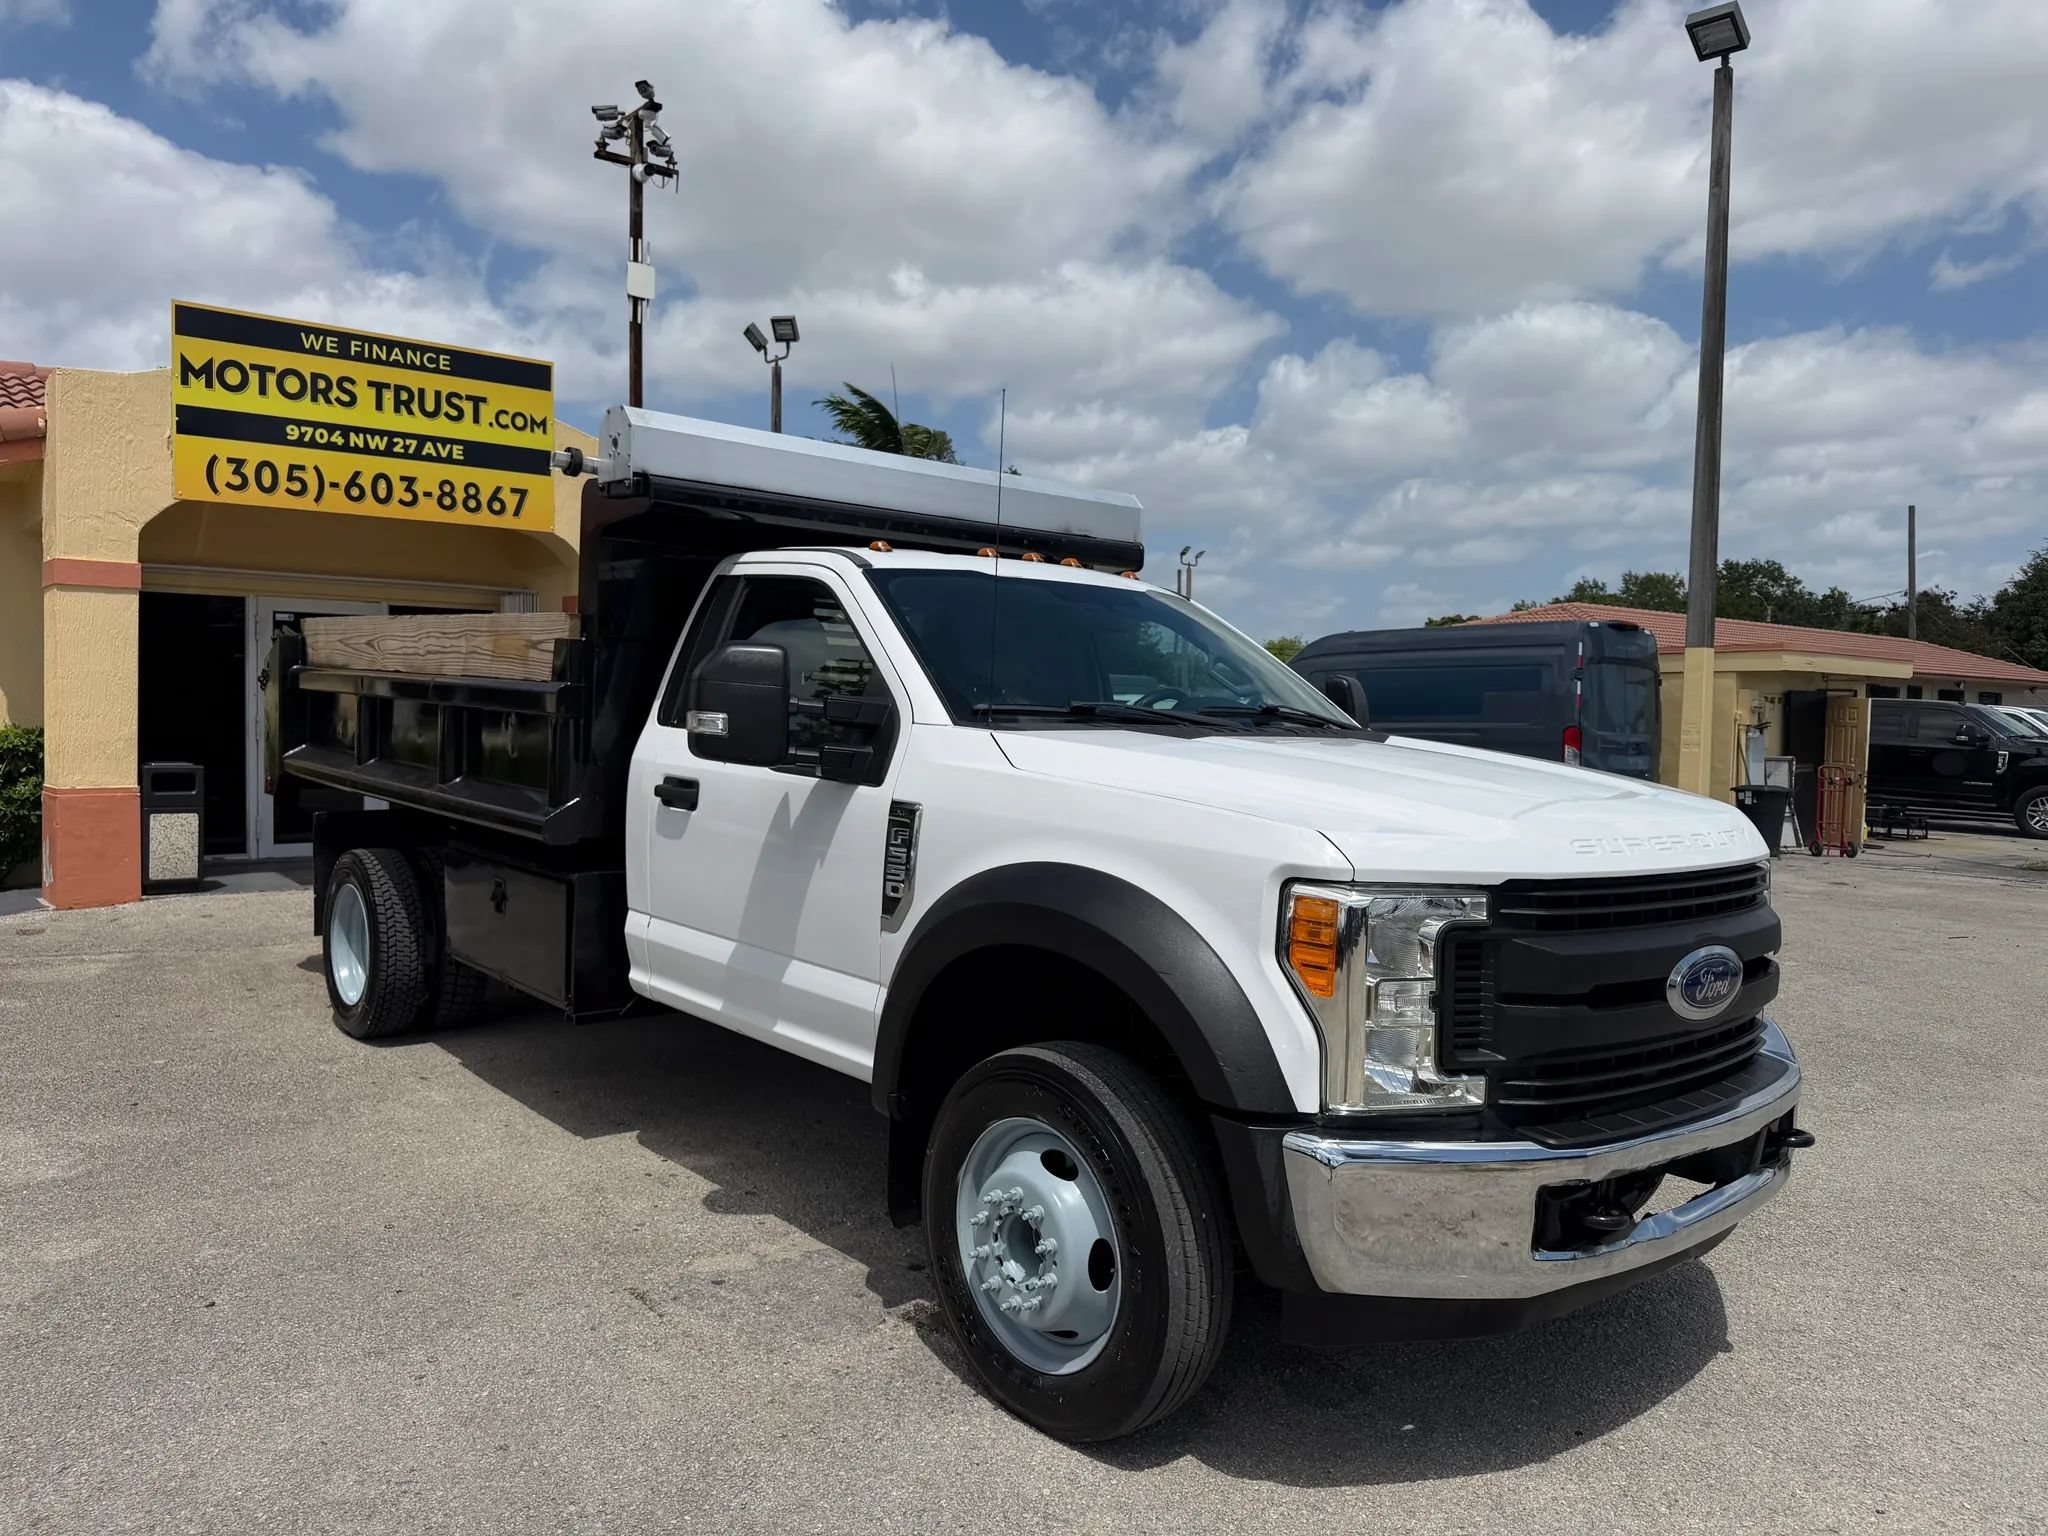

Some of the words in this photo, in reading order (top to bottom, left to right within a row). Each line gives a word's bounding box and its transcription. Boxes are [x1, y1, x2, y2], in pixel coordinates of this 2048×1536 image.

[300, 331, 340, 354] WE
[350, 339, 452, 371] FINANCE
[179, 351, 359, 409] MOTORS
[285, 423, 345, 447] 9704
[349, 431, 388, 452] NW
[392, 436, 418, 455] 27
[421, 440, 465, 461] AVE
[205, 453, 530, 519] (305)-603-8867
[1569, 835, 1686, 857] SUPER
[1696, 965, 1730, 1001] Ford
